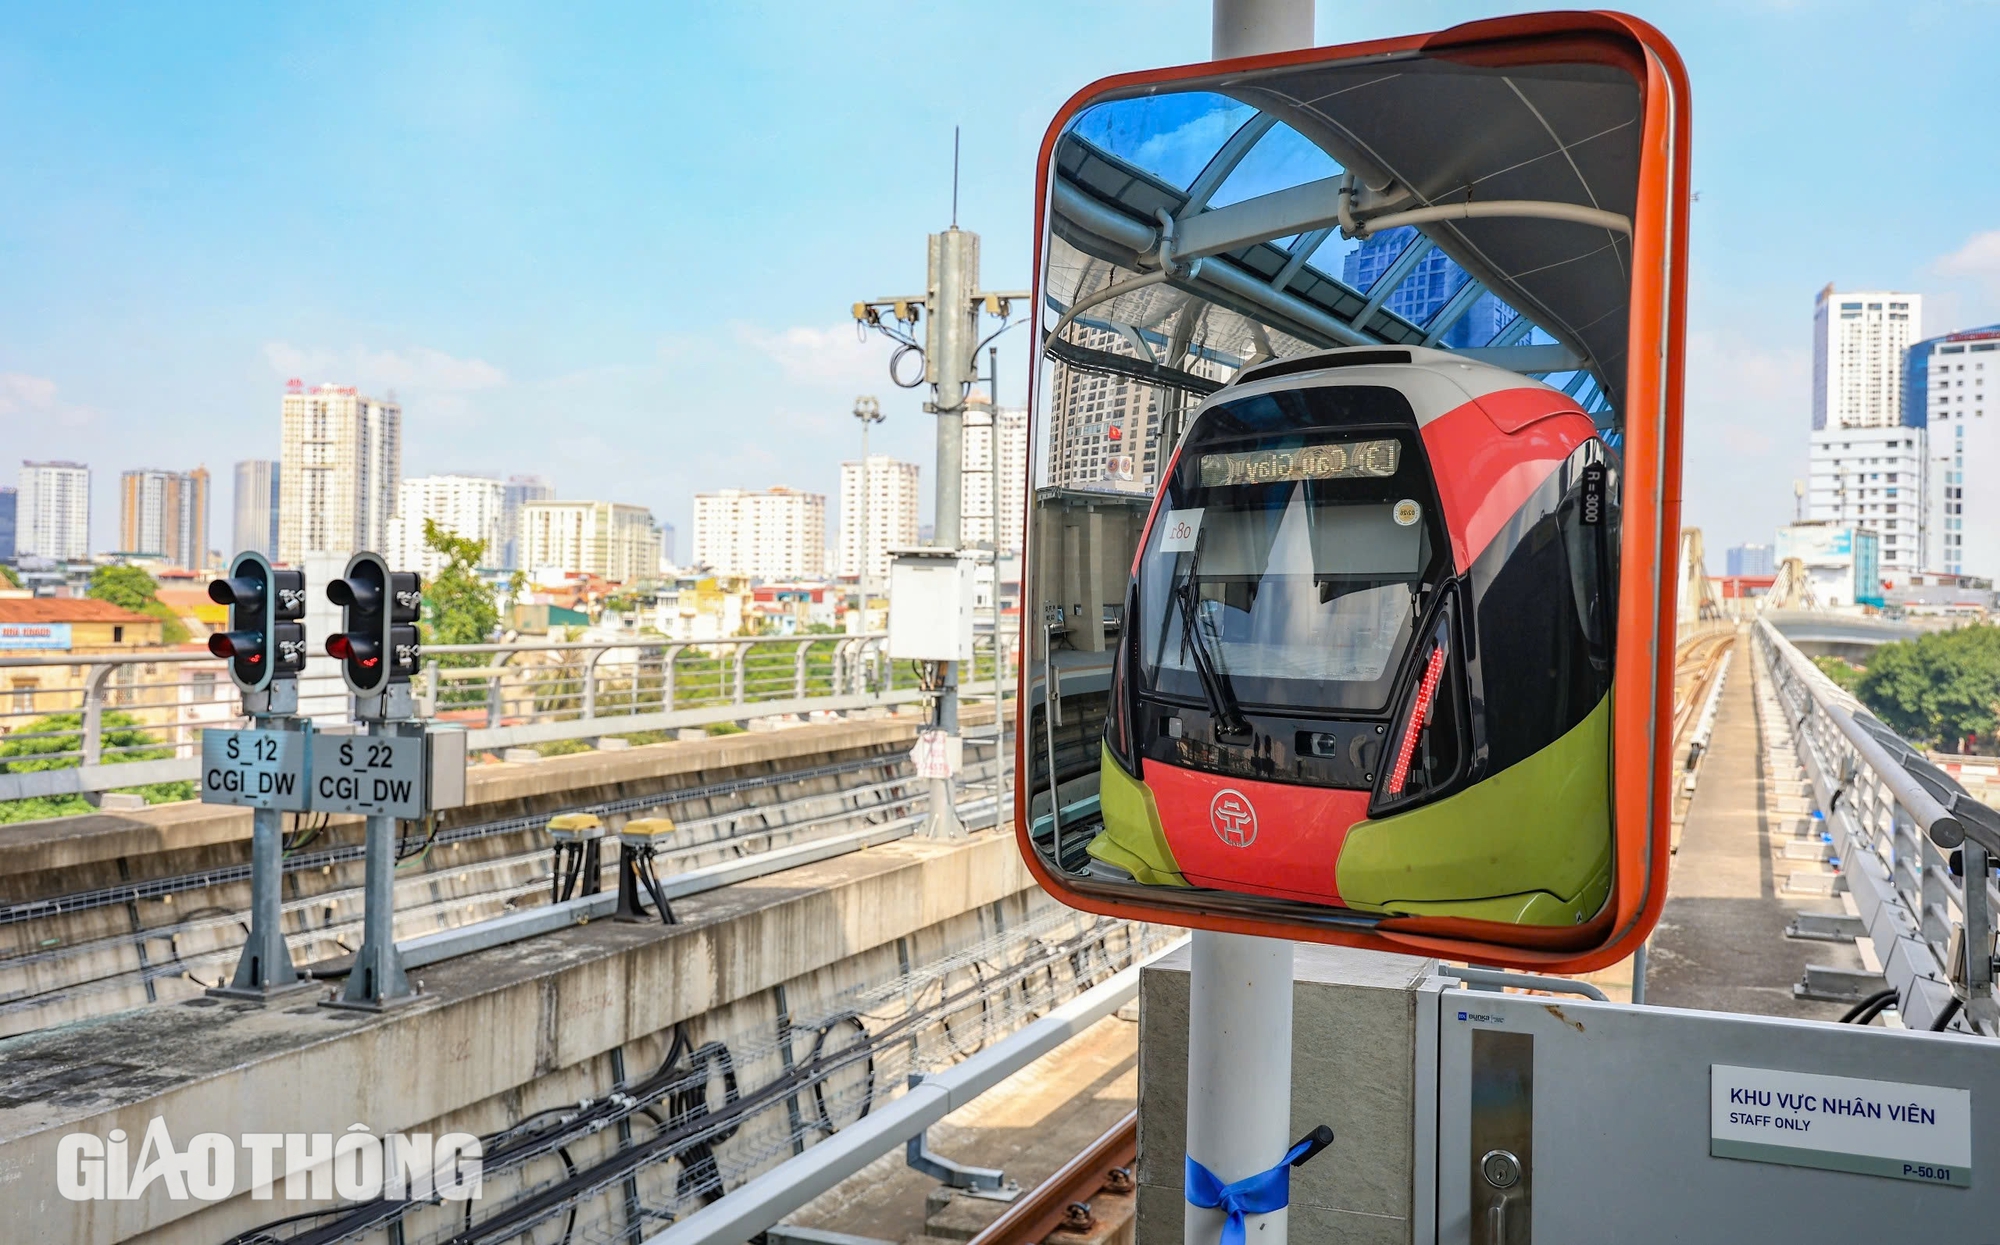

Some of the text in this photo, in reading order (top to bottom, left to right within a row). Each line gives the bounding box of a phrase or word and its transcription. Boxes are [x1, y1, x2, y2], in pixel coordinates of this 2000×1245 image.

[1587, 471, 1600, 480] R
[1585, 493, 1599, 522] 3000
[226, 737, 277, 766] S_12
[339, 744, 393, 773] S_22
[207, 768, 296, 799] CGI_DW
[319, 775, 412, 807] CGI_DW
[1730, 1087, 1936, 1125] KHU VỰC NHÂN VIÊN
[1730, 1112, 1811, 1132] STAFF ONLY
[1903, 1164, 1950, 1181] P-50.01
